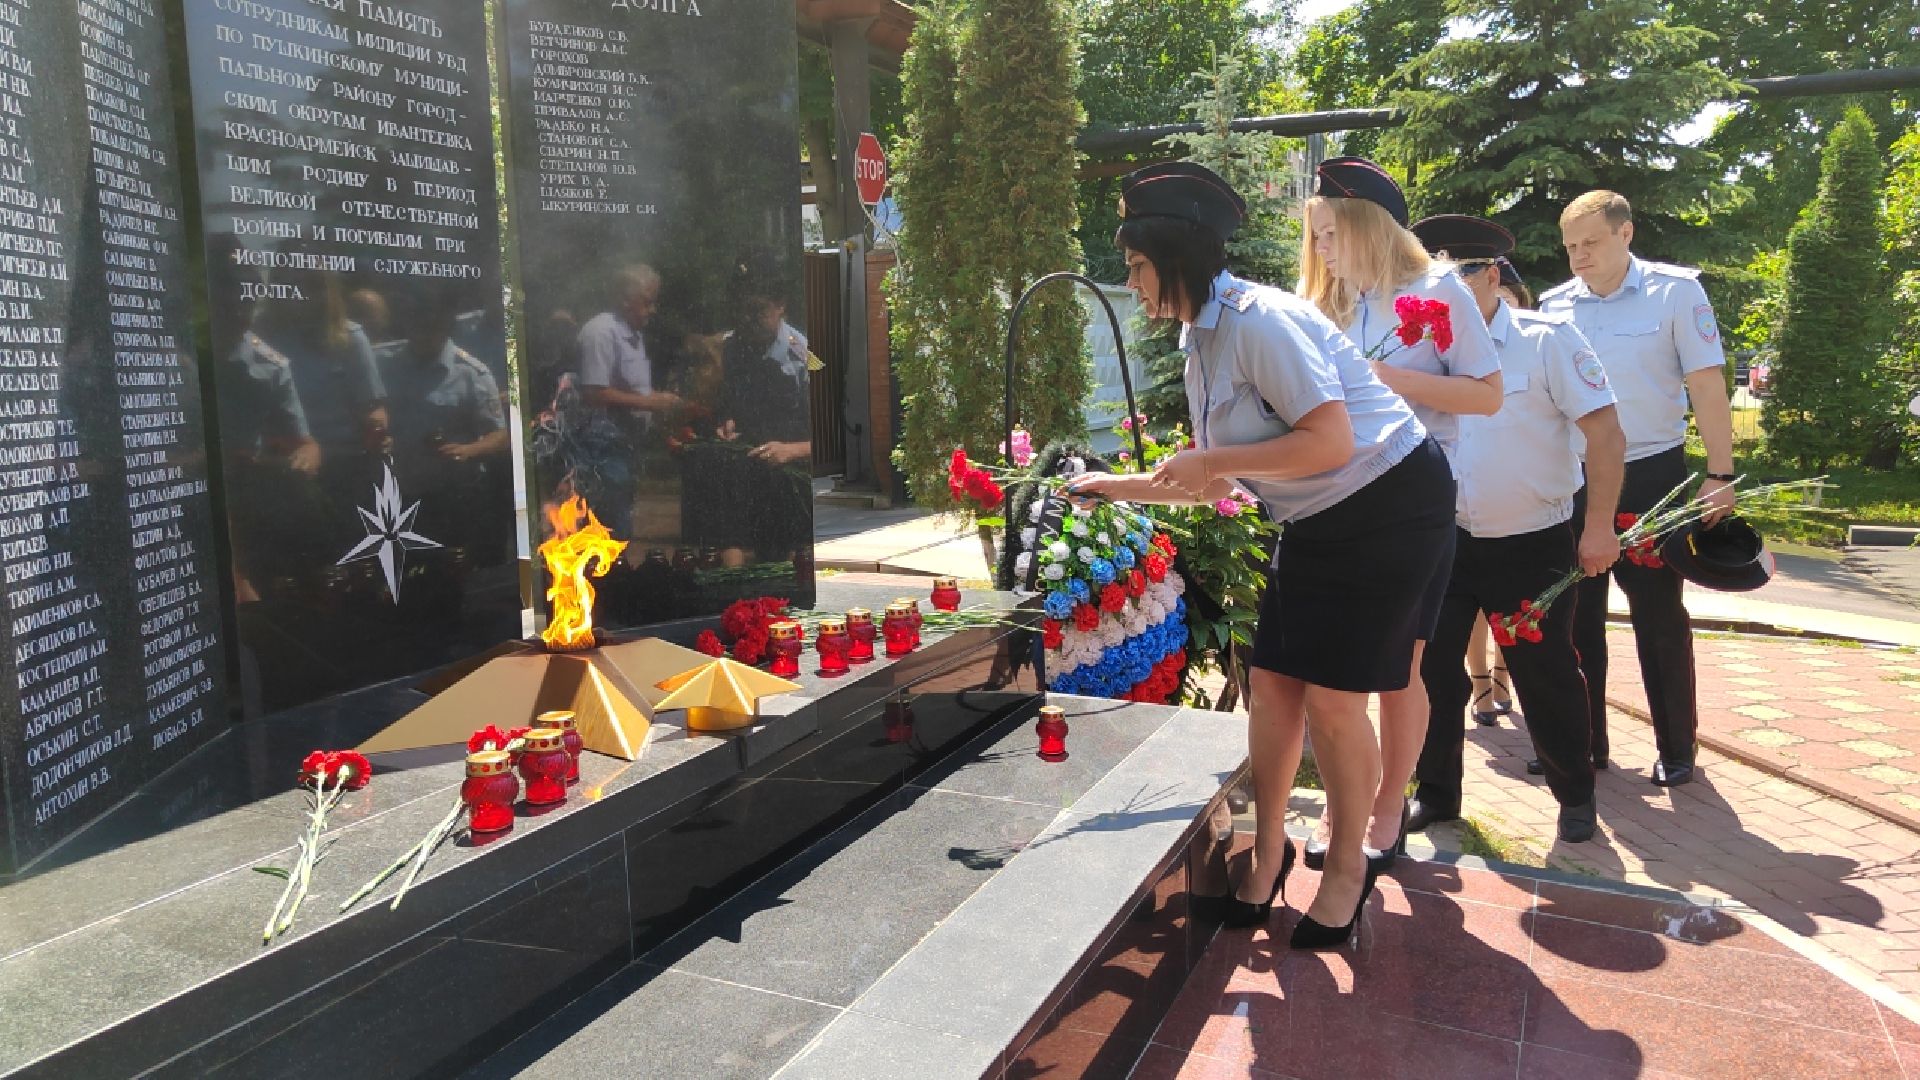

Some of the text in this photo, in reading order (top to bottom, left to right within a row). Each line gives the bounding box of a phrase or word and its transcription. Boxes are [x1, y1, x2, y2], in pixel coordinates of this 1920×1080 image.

[215, 0, 467, 77] СОТРУДНИКАМ МИЛИЦИИ УВД
[358, 0, 442, 38] ПАМЯТЬ
[216, 25, 244, 44] ПО
[252, 34, 383, 77] ПУШКИНСКОМУ
[219, 57, 322, 92] ПАЛЬНОМУ
[333, 82, 396, 109] РАЙОНУ
[224, 91, 473, 151] СКИМ ОКРУГАМ ИВАНТЕЕВКА
[224, 121, 378, 162] КРАСНОАРМЕЙСК
[303, 165, 369, 189] РОДИНУ
[386, 177, 397, 192] В
[413, 181, 477, 207] ПЕРИОД
[857, 157, 884, 181] STOP
[230, 185, 479, 230] ВЕЛИКОЙ ОТЕЧЕСТВЕННОЙ
[231, 216, 302, 240] ВОЙНЫ
[312, 225, 325, 241] И
[435, 236, 466, 253] ПРИ
[233, 249, 356, 272] ИСПОЛНЕНИИ
